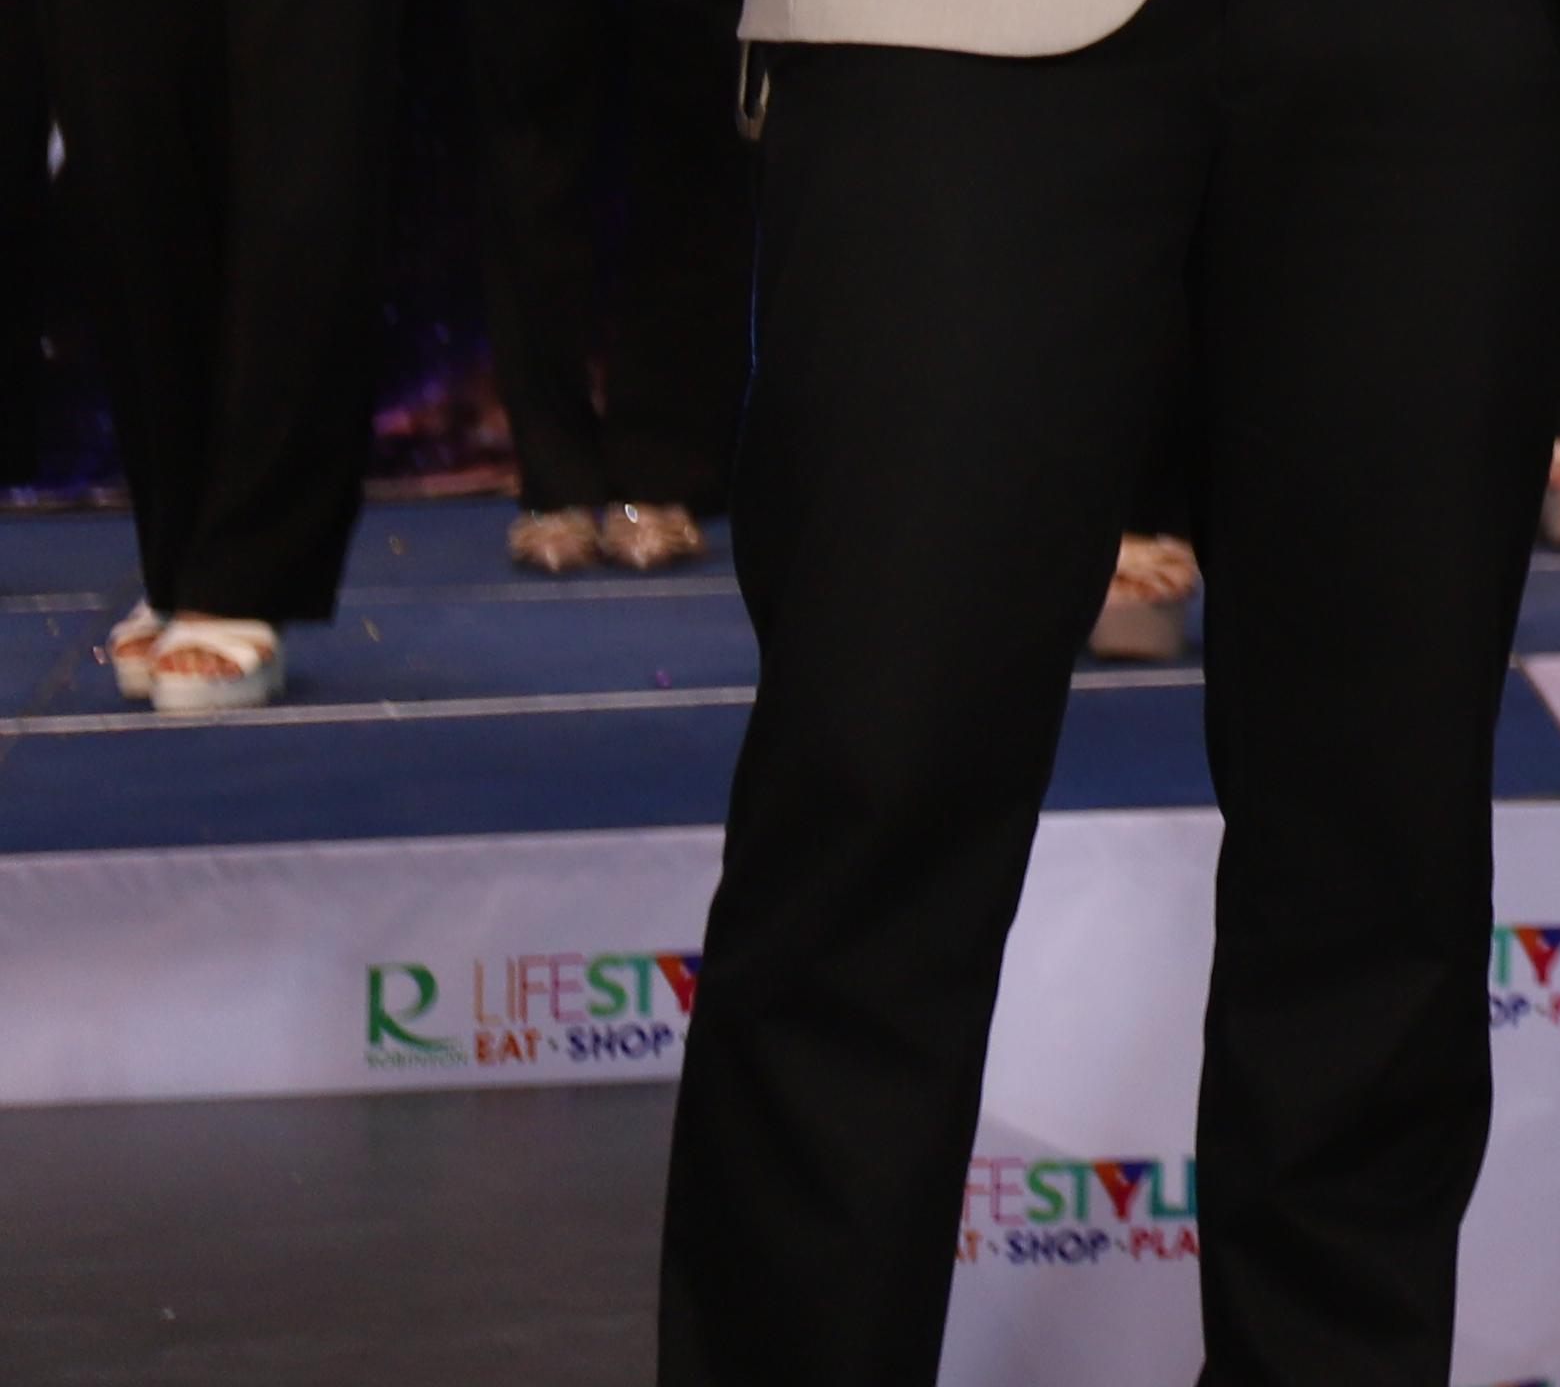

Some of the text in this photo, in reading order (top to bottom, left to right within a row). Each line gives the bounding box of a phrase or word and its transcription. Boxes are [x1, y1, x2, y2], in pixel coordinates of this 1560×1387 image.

[473, 1023, 673, 1065] EAT SHOP
[1005, 1228, 1112, 1265] SHOP
[1129, 1227, 1199, 1261] PLA
